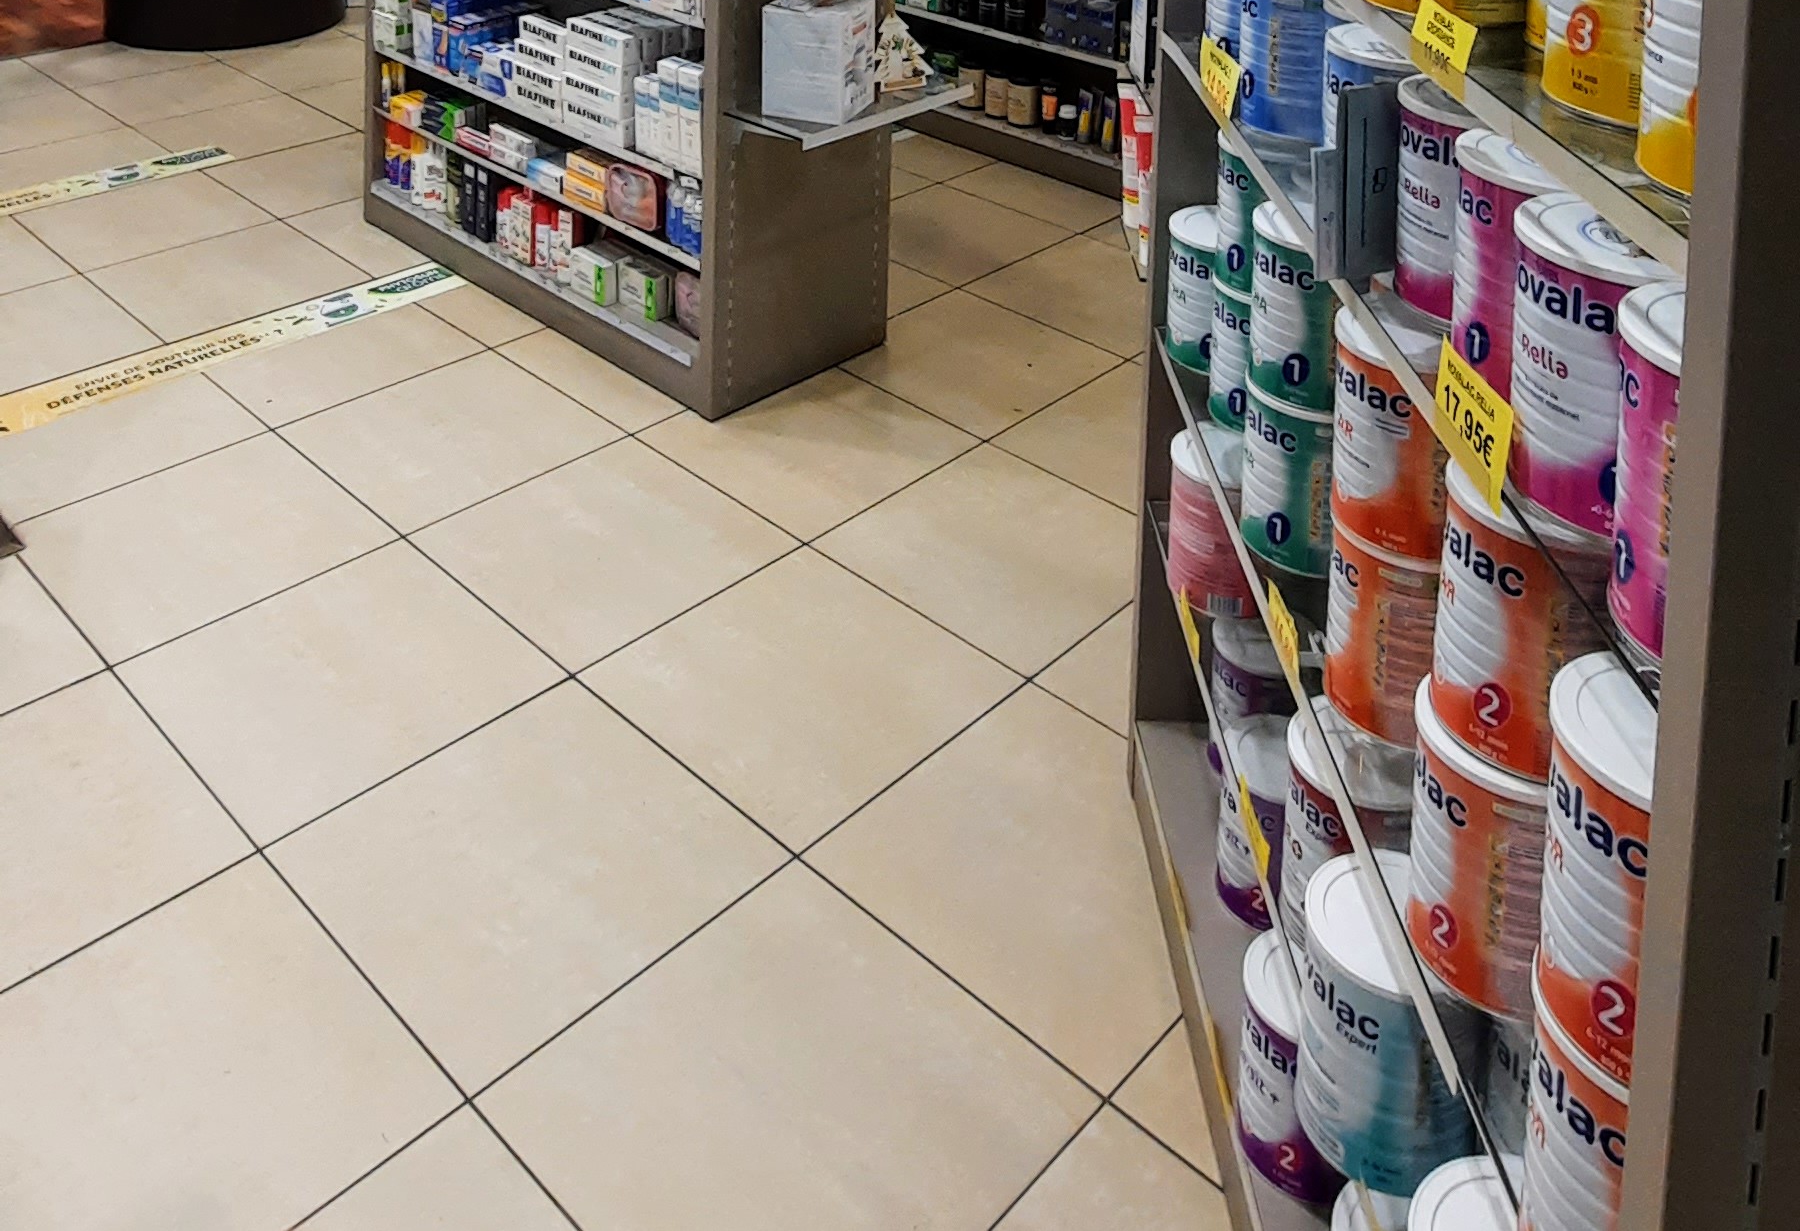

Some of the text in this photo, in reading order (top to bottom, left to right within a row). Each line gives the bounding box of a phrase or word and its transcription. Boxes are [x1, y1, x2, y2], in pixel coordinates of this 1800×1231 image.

[522, 20, 558, 44] BIAFINE
[570, 22, 603, 43] BIAFINE
[1573, 12, 1594, 52] 3
[518, 43, 556, 67] BIAFINE
[568, 49, 601, 70] BIAFINE
[515, 65, 554, 89] BIAFINE
[565, 76, 600, 97] BIAFINE
[516, 85, 556, 110] BIAFINE
[567, 102, 602, 124] BIAFINE
[1403, 177, 1442, 210] Relia
[1231, 247, 1240, 269] 1
[148, 335, 262, 376] NATURELLES
[1470, 328, 1482, 360] 1
[74, 332, 247, 391] ENVIE DE SOUTENIR VOS
[1521, 333, 1570, 381] Relia
[1289, 358, 1302, 382] 1
[1232, 391, 1242, 413] 1
[1272, 516, 1283, 542] 1
[1479, 687, 1500, 727] 2
[1250, 888, 1264, 911] 2
[1431, 906, 1450, 950] 2
[1598, 984, 1627, 1037] 2
[1335, 1021, 1378, 1056] Expert
[1278, 1144, 1296, 1171] 2
